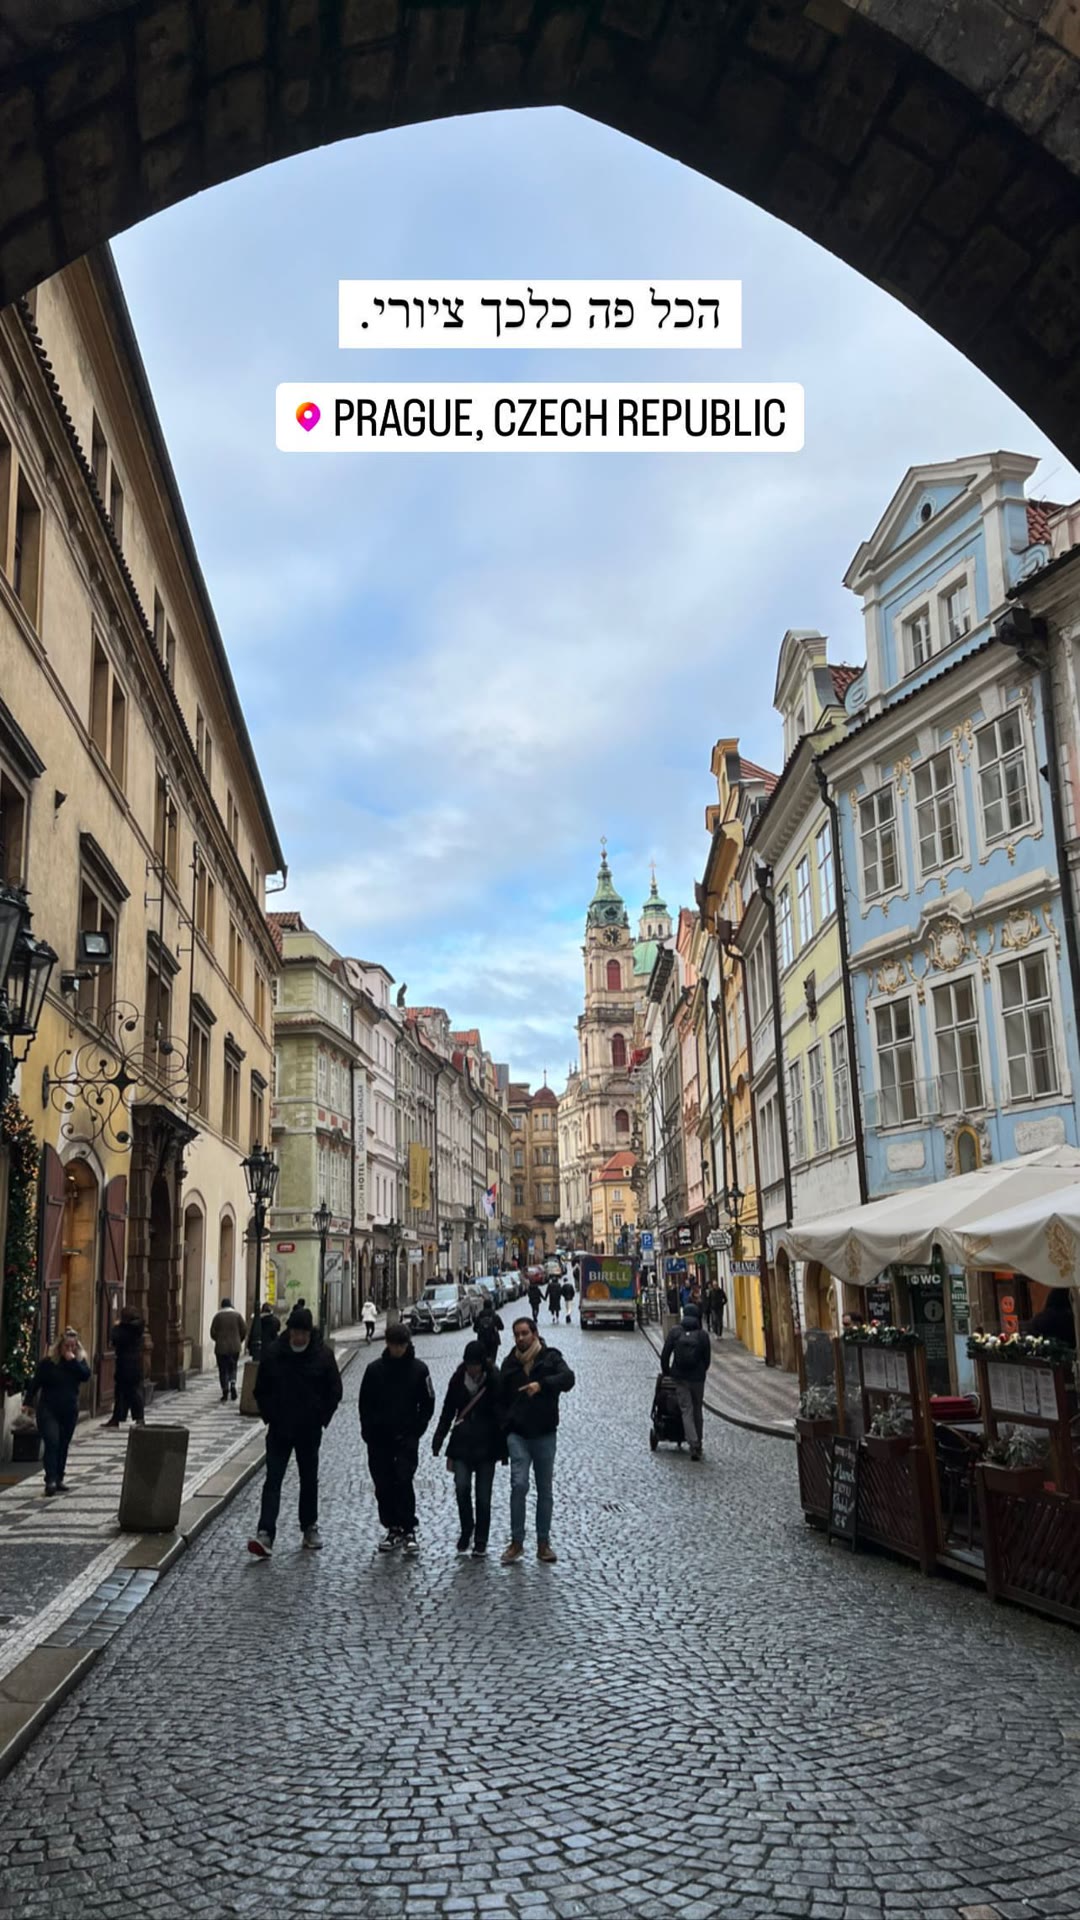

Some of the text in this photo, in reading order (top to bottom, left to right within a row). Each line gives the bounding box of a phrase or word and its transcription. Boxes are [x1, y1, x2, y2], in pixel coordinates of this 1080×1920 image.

[730, 1261, 760, 1273] CHANGE
[588, 1271, 628, 1281] BIRELL
[920, 1274, 941, 1285] WC
